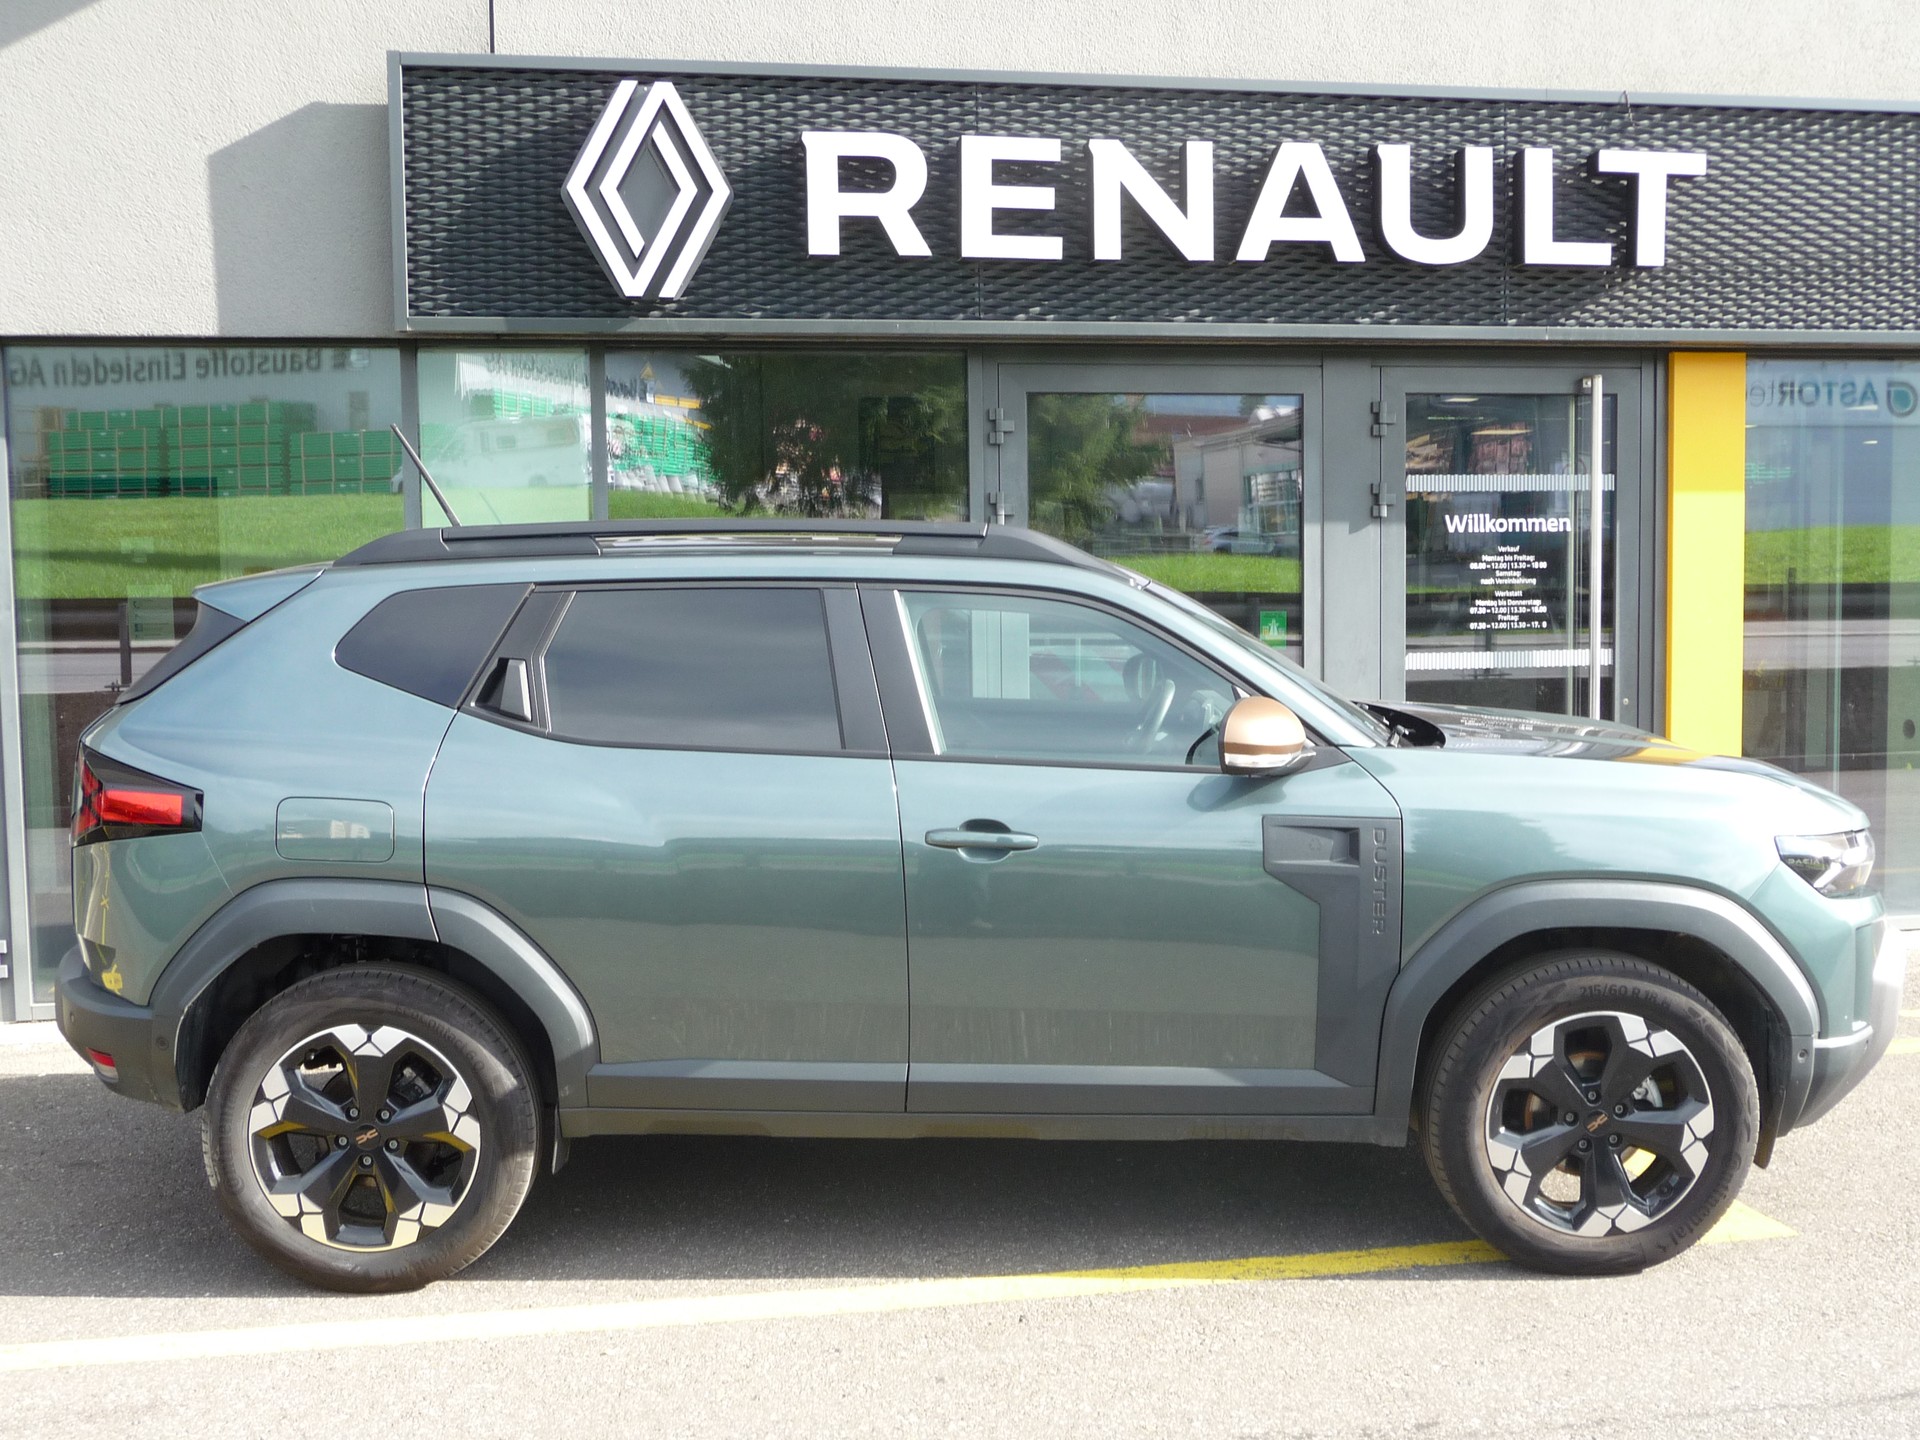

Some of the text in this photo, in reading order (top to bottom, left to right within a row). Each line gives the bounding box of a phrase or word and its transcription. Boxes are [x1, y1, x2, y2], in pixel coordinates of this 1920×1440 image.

[801, 131, 1707, 267] RENAULT
[1445, 514, 1571, 533] Willkommen
[1497, 545, 1520, 553] Verkauf
[1475, 599, 1498, 607] Montag
[1787, 857, 1820, 865] DACIA
[1372, 827, 1387, 935] DUSTER
[1579, 984, 1628, 999] 215/60
